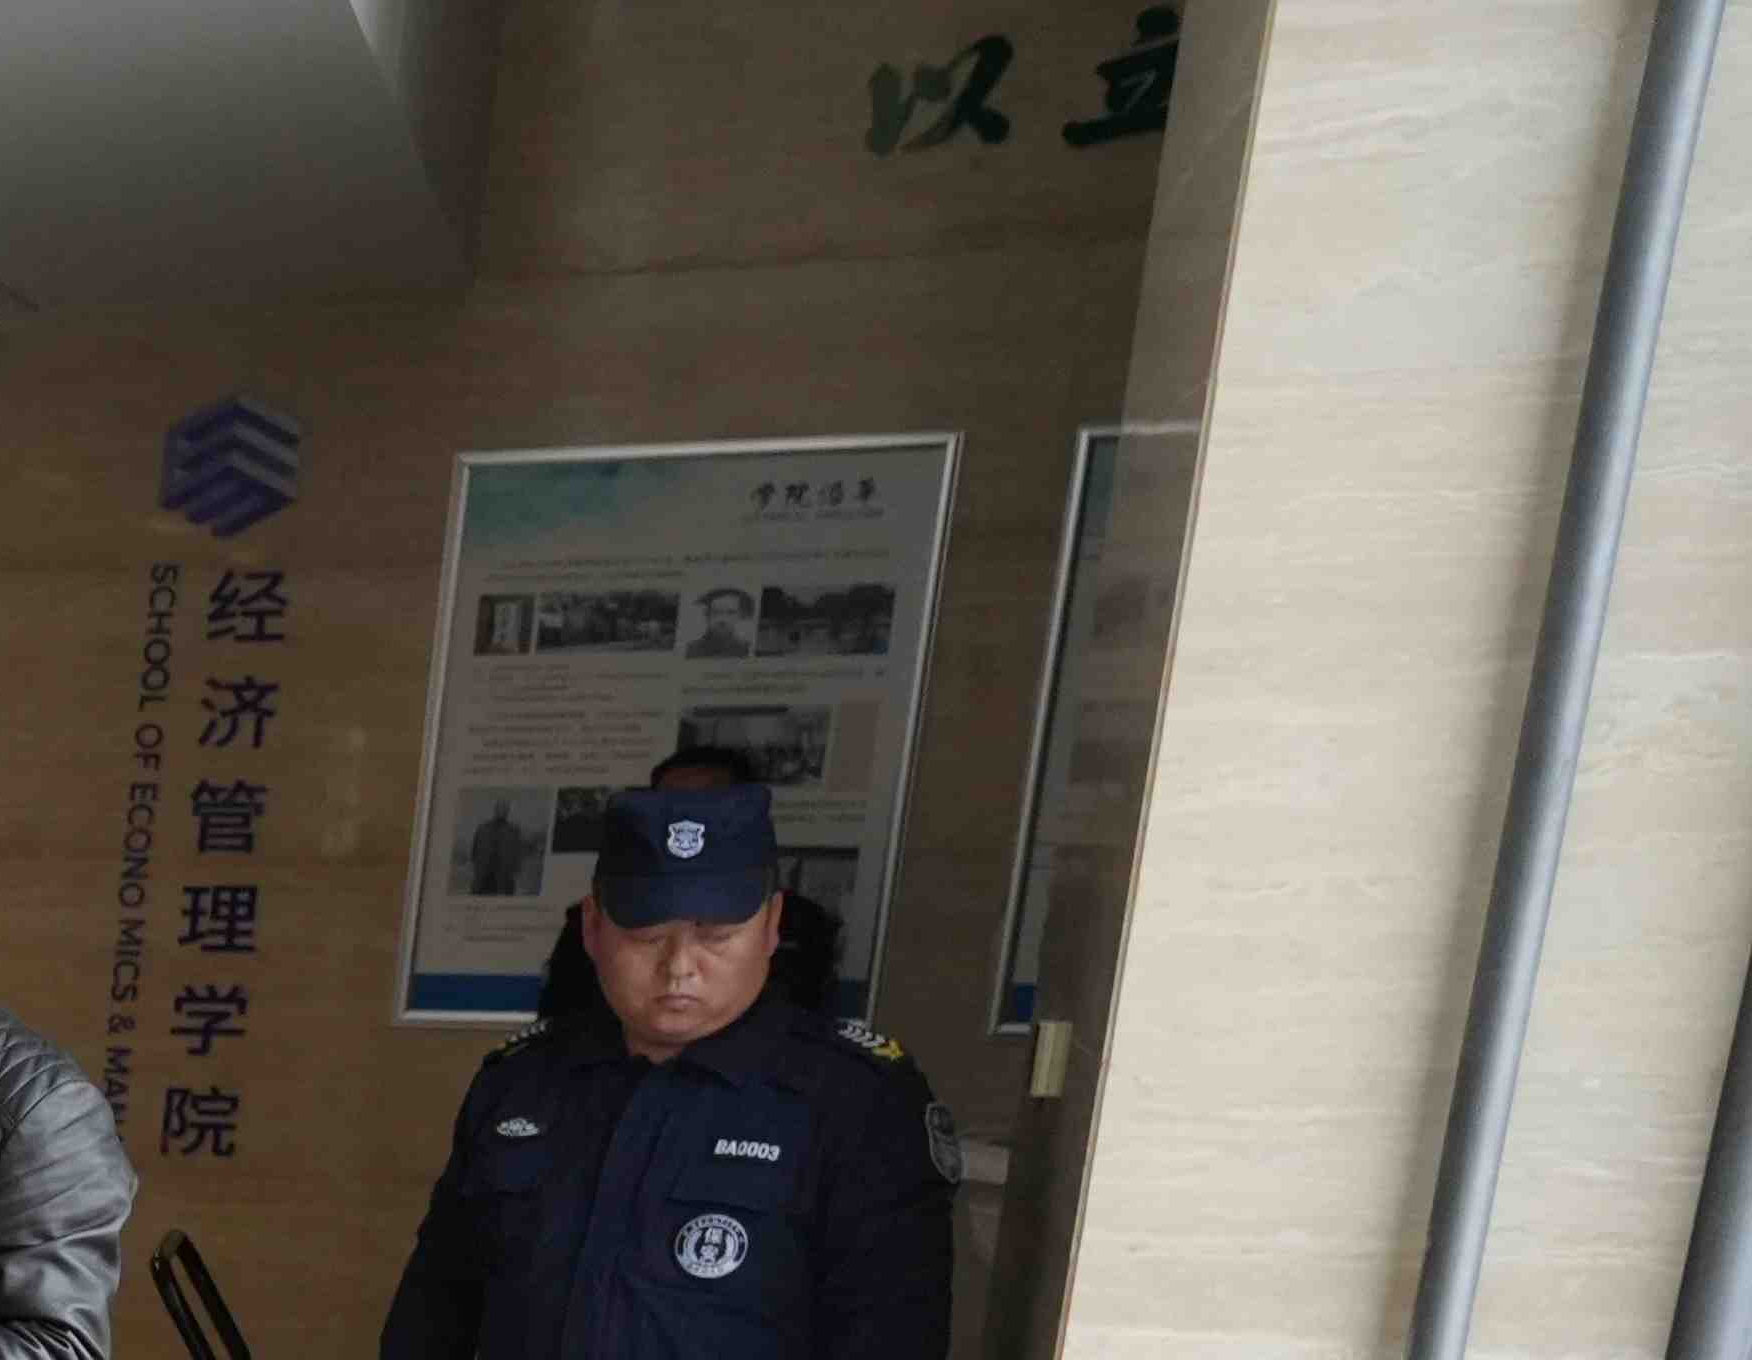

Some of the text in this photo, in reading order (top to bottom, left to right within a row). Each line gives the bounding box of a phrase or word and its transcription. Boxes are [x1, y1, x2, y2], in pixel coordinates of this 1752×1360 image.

[138, 563, 178, 712] SCHOOL
[132, 723, 164, 771] OF
[157, 567, 288, 1156] 经济管理学院
[107, 1014, 136, 1035] &
[714, 1139, 780, 1162] BA0003
